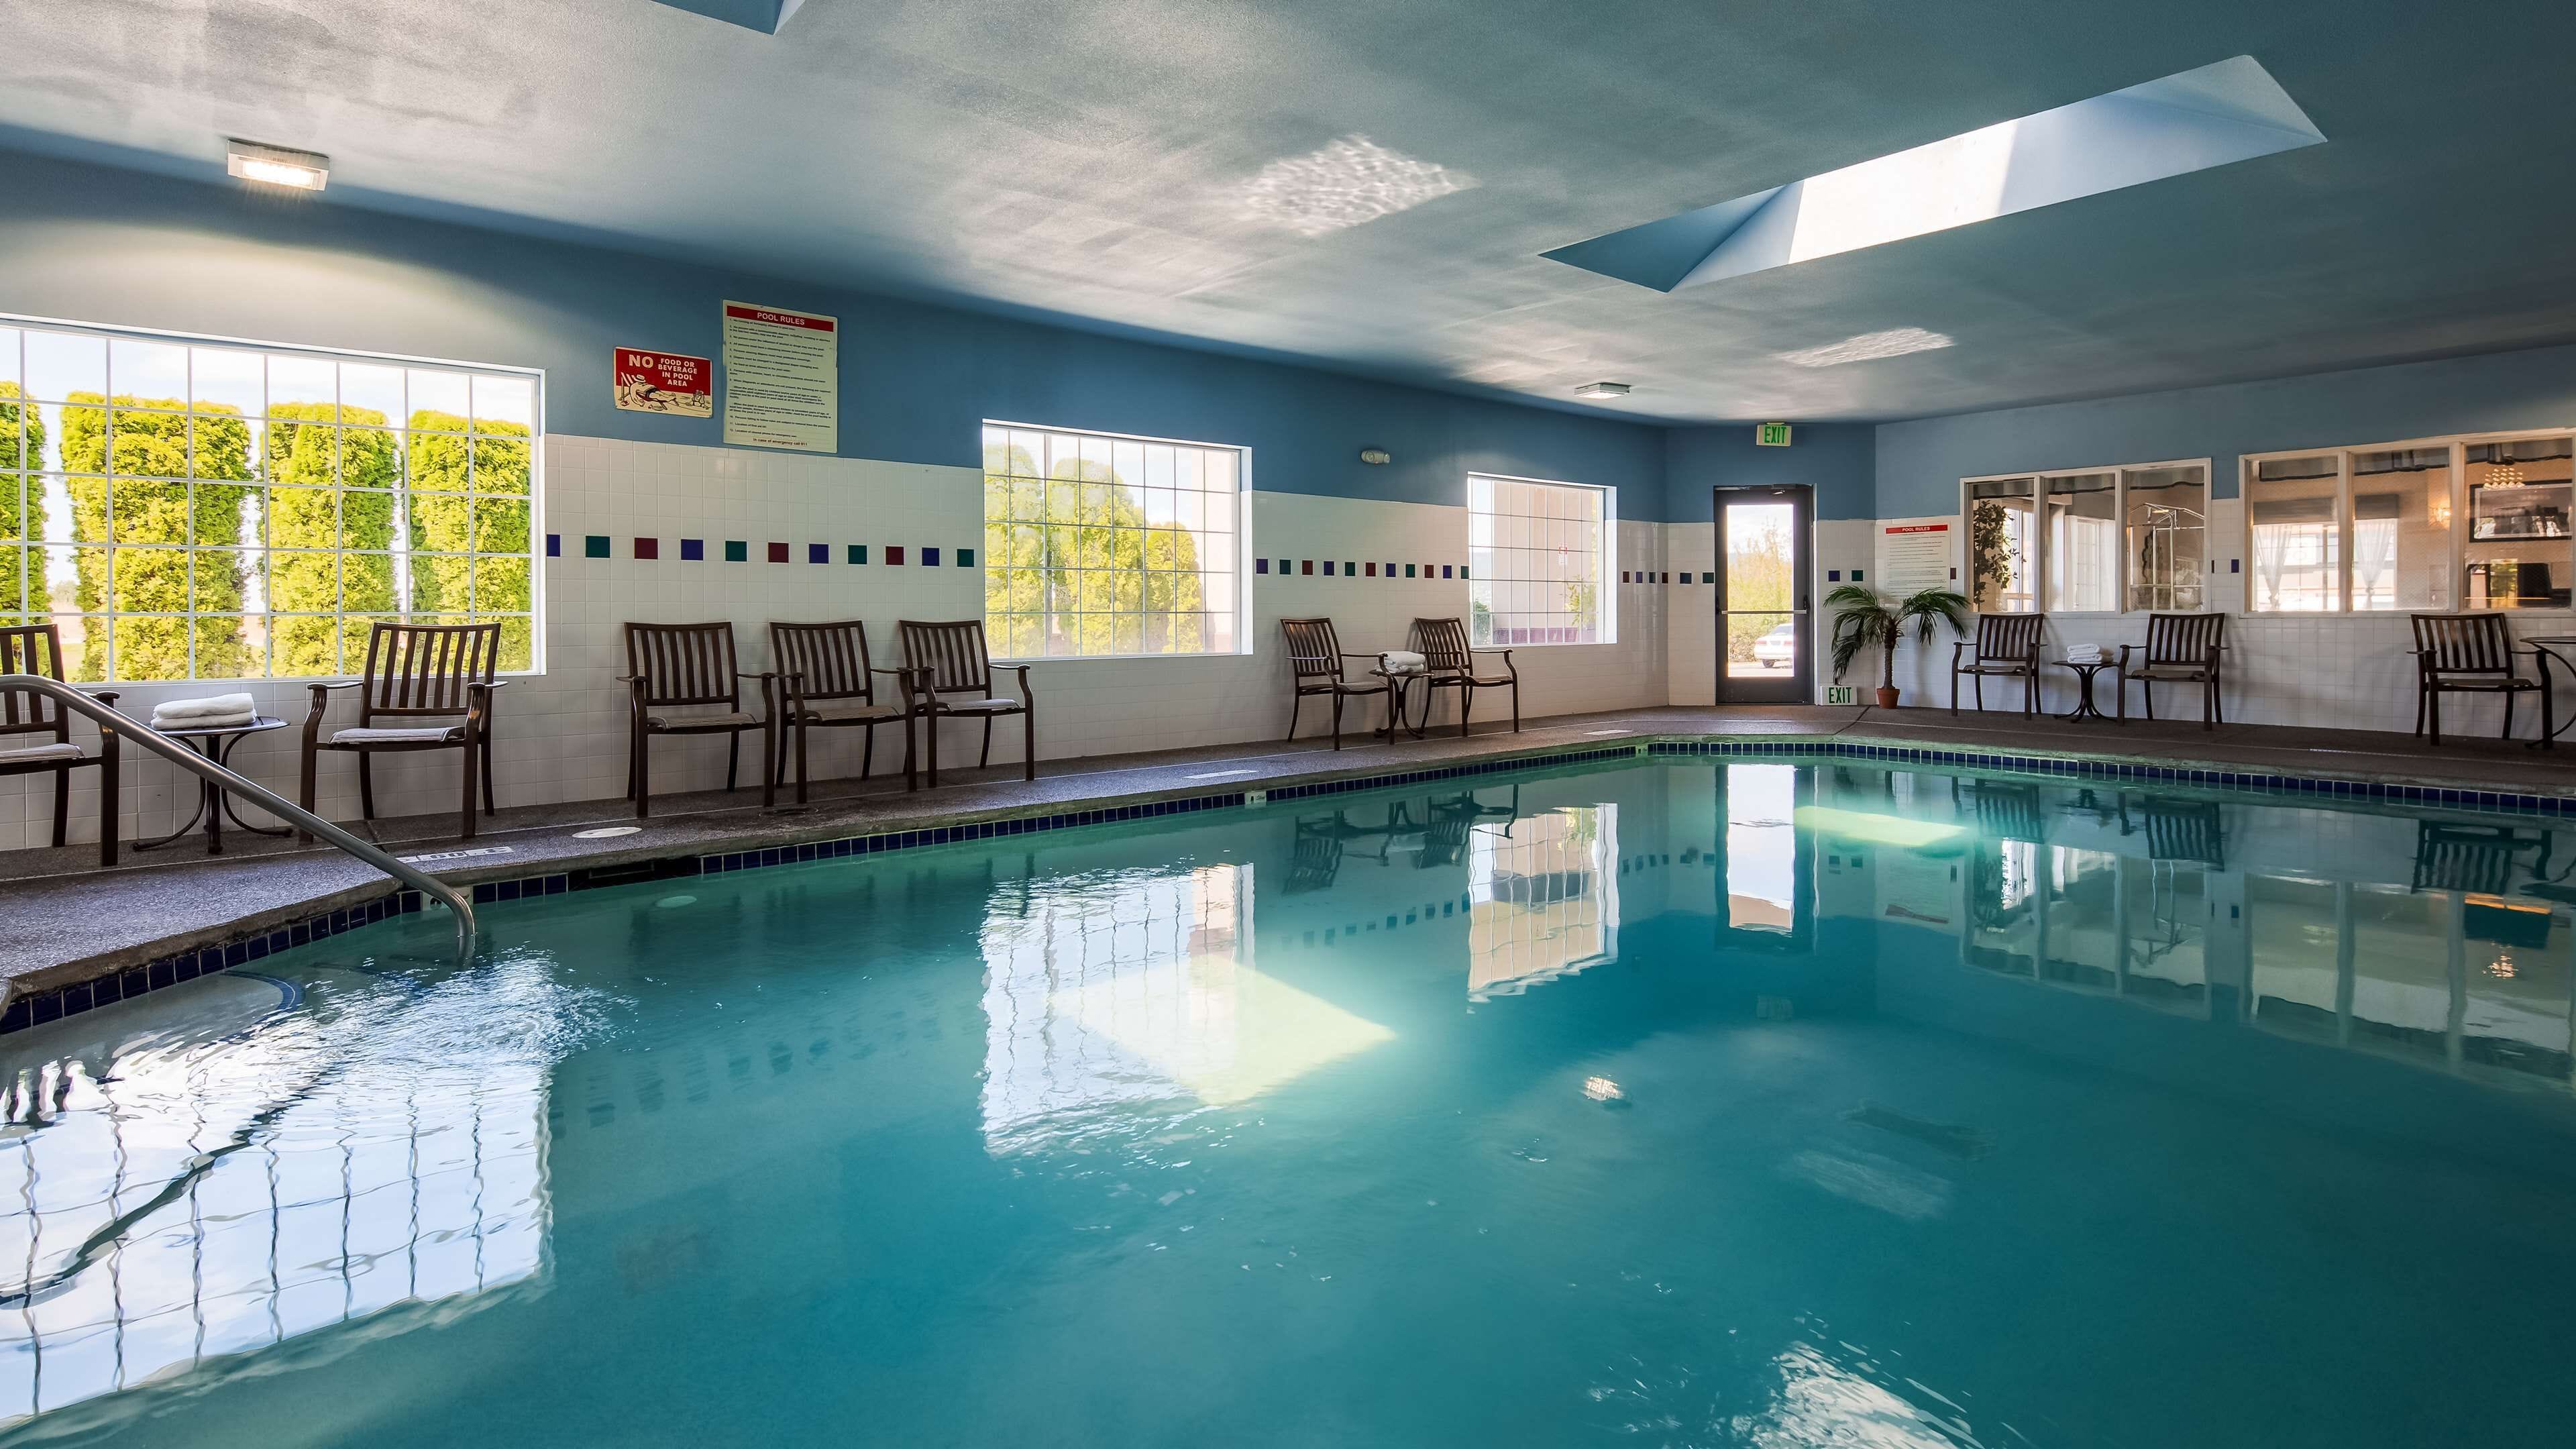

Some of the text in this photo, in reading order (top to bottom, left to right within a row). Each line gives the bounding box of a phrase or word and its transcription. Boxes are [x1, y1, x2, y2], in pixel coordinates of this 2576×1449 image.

[757, 312, 805, 325] POOL RULES
[629, 354, 653, 368] NO
[658, 364, 697, 374] BEVERAGE
[667, 379, 688, 387] AREA
[1764, 426, 1786, 443] EXIT
[1829, 687, 1851, 704] EXIT
